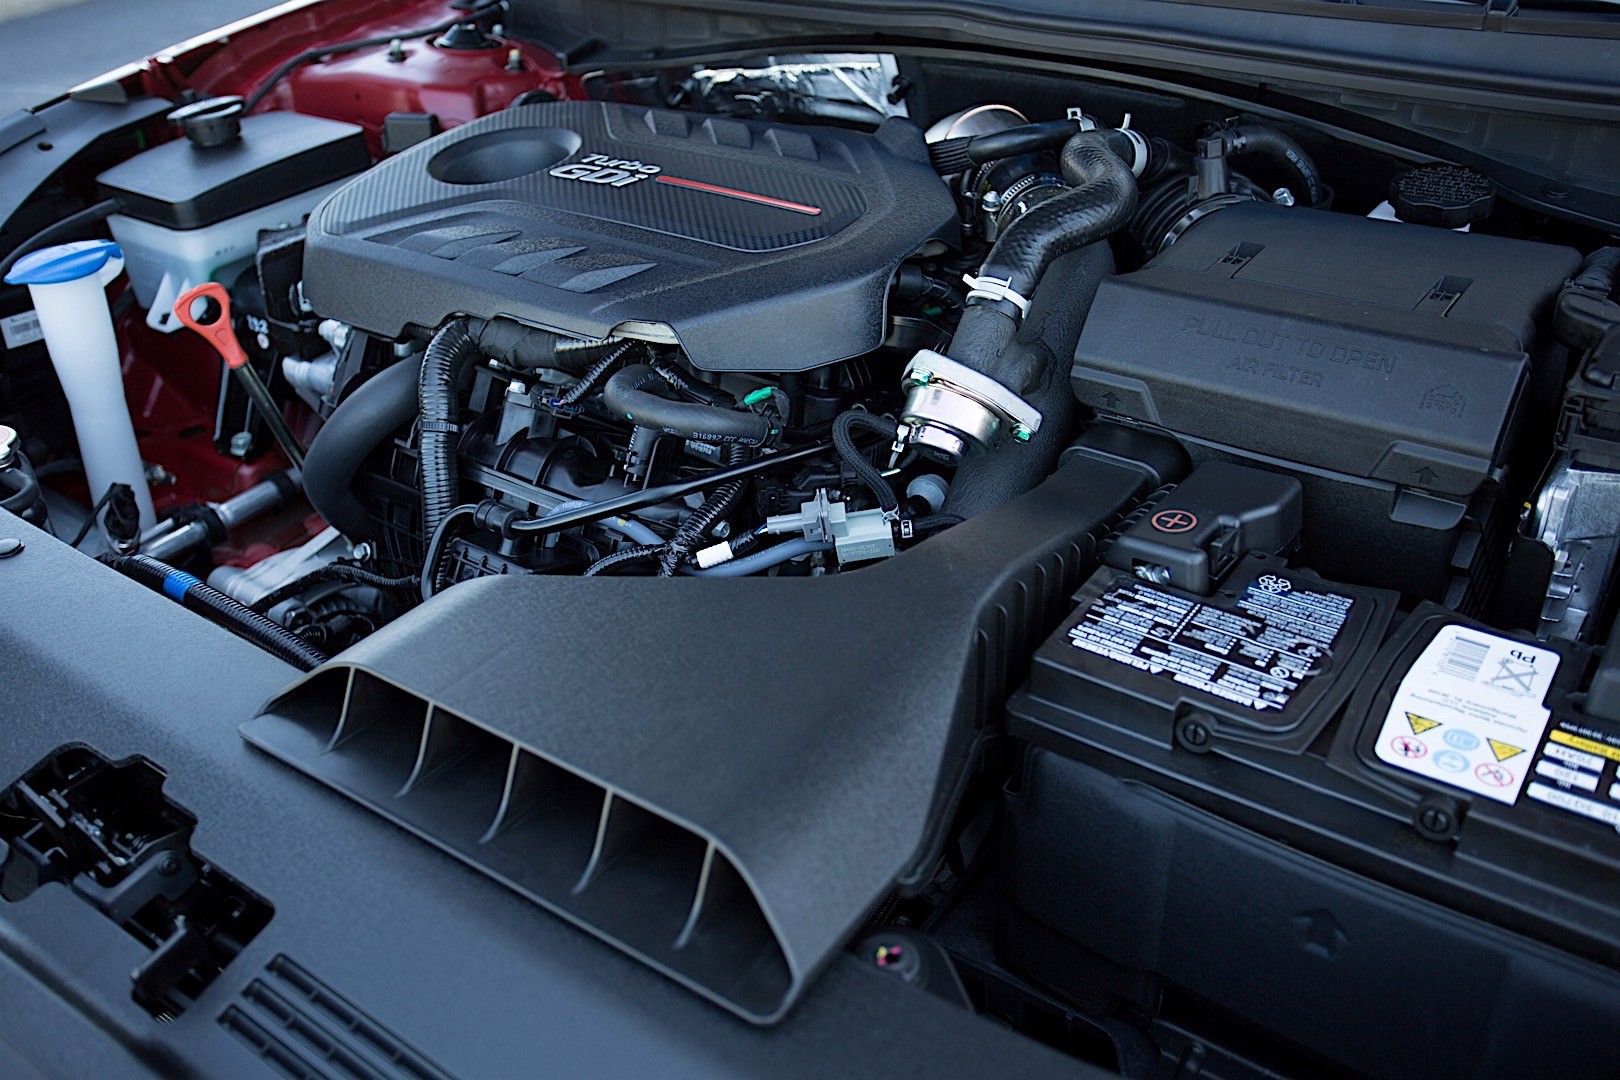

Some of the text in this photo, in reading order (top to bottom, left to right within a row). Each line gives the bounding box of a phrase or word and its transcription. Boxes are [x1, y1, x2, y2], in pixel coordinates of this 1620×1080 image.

[581, 153, 661, 174] Turbo
[1182, 314, 1397, 374] PULL OUT TO OPEN
[1227, 355, 1325, 388] AIR FILTER
[1510, 650, 1536, 664] Pb
